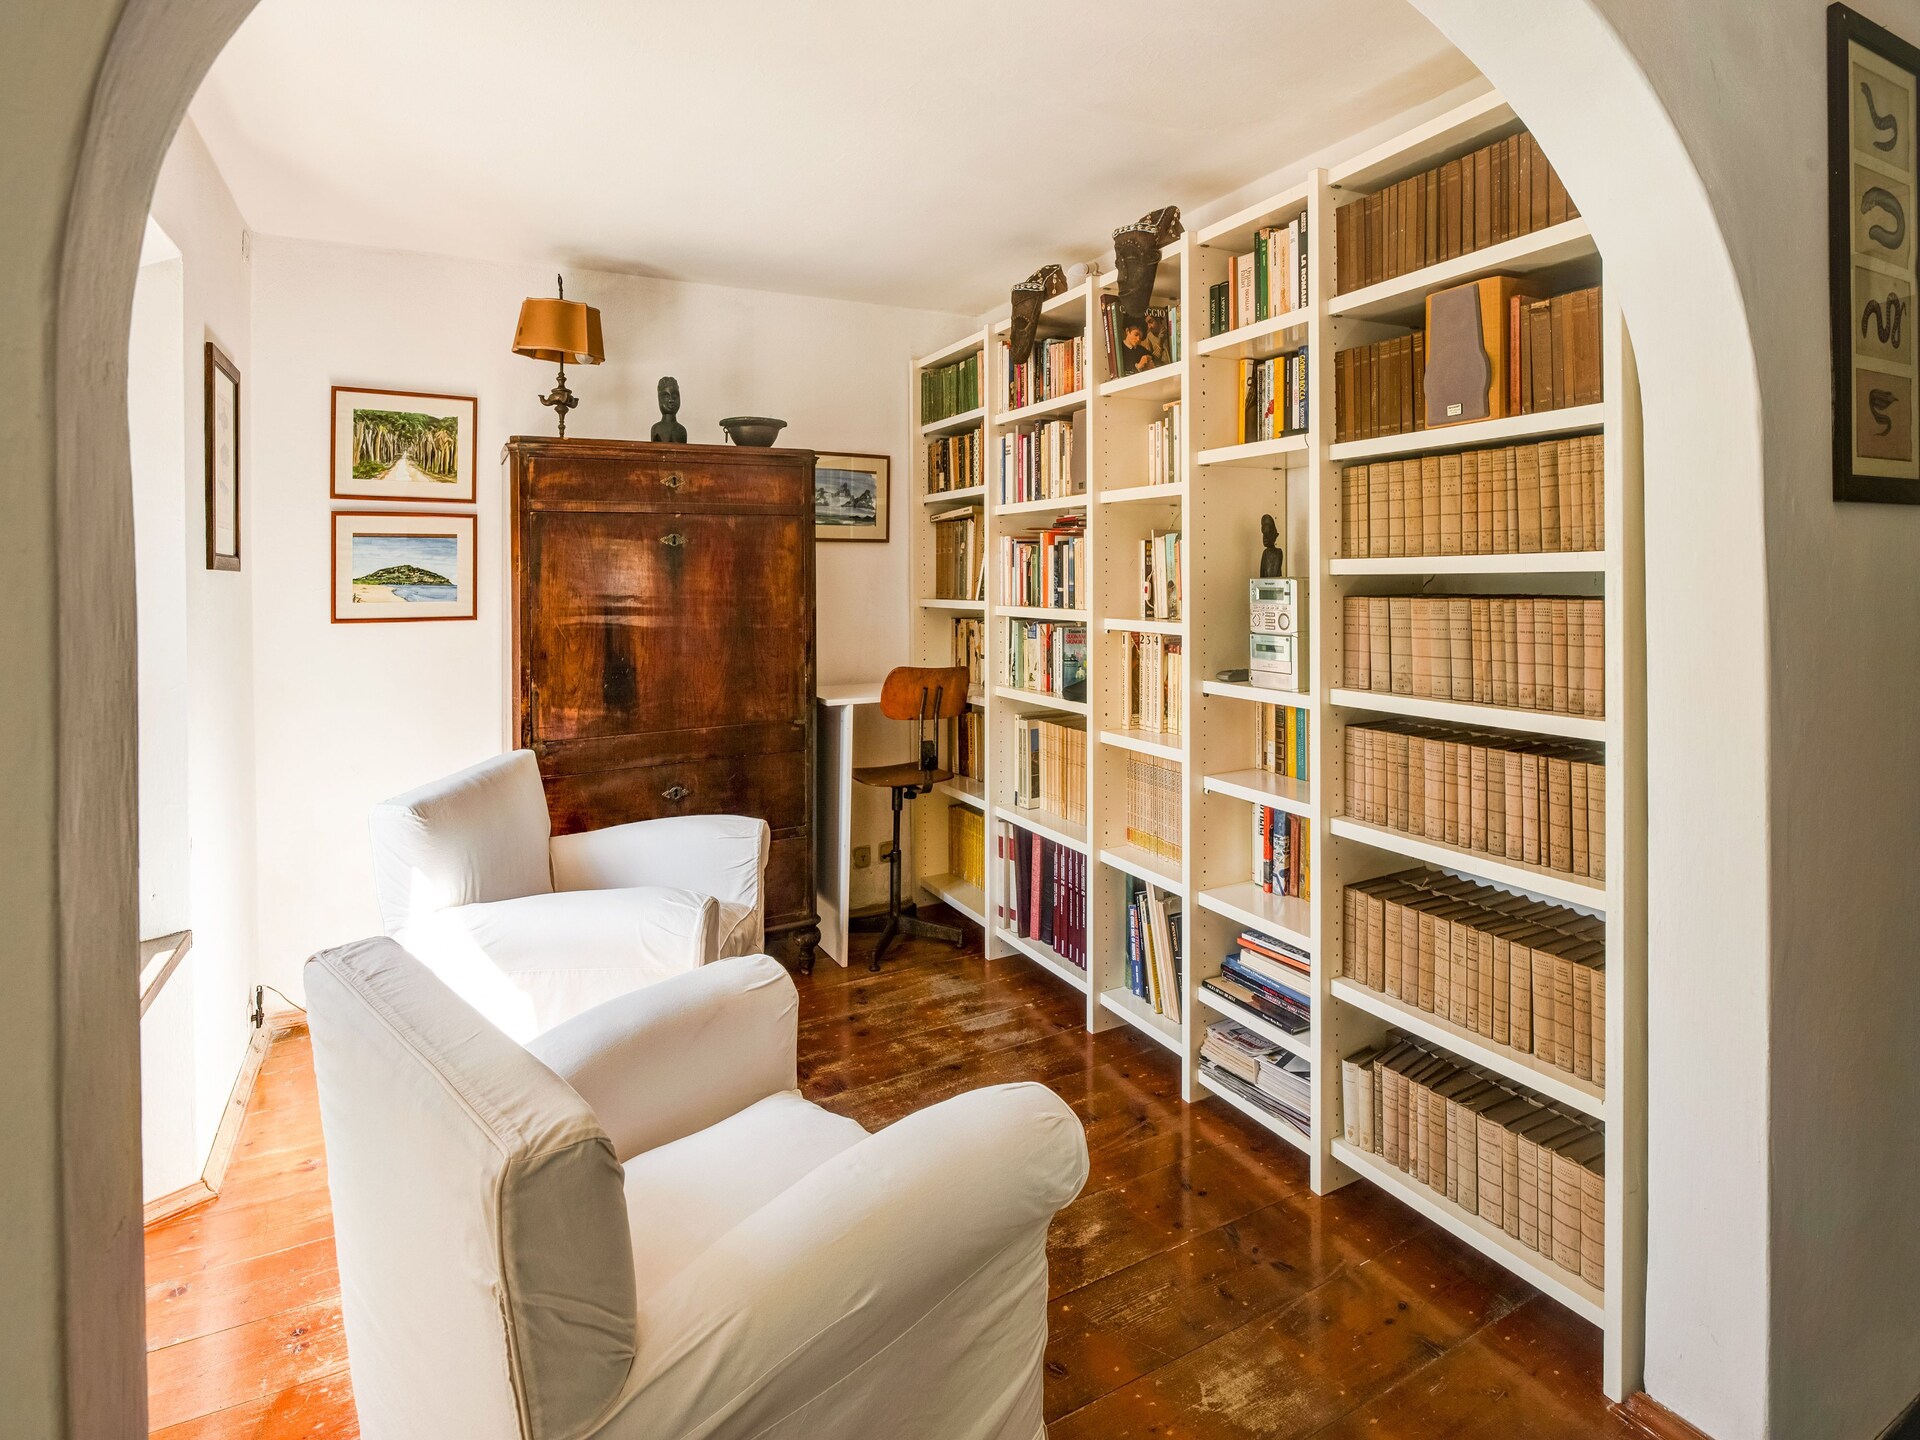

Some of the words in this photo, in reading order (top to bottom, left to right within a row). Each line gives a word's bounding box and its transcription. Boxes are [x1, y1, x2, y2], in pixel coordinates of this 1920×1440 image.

[1301, 254, 1306, 266] LA
[1140, 634, 1144, 644] 2
[1146, 634, 1151, 644] 3
[1153, 635, 1159, 645] 4
